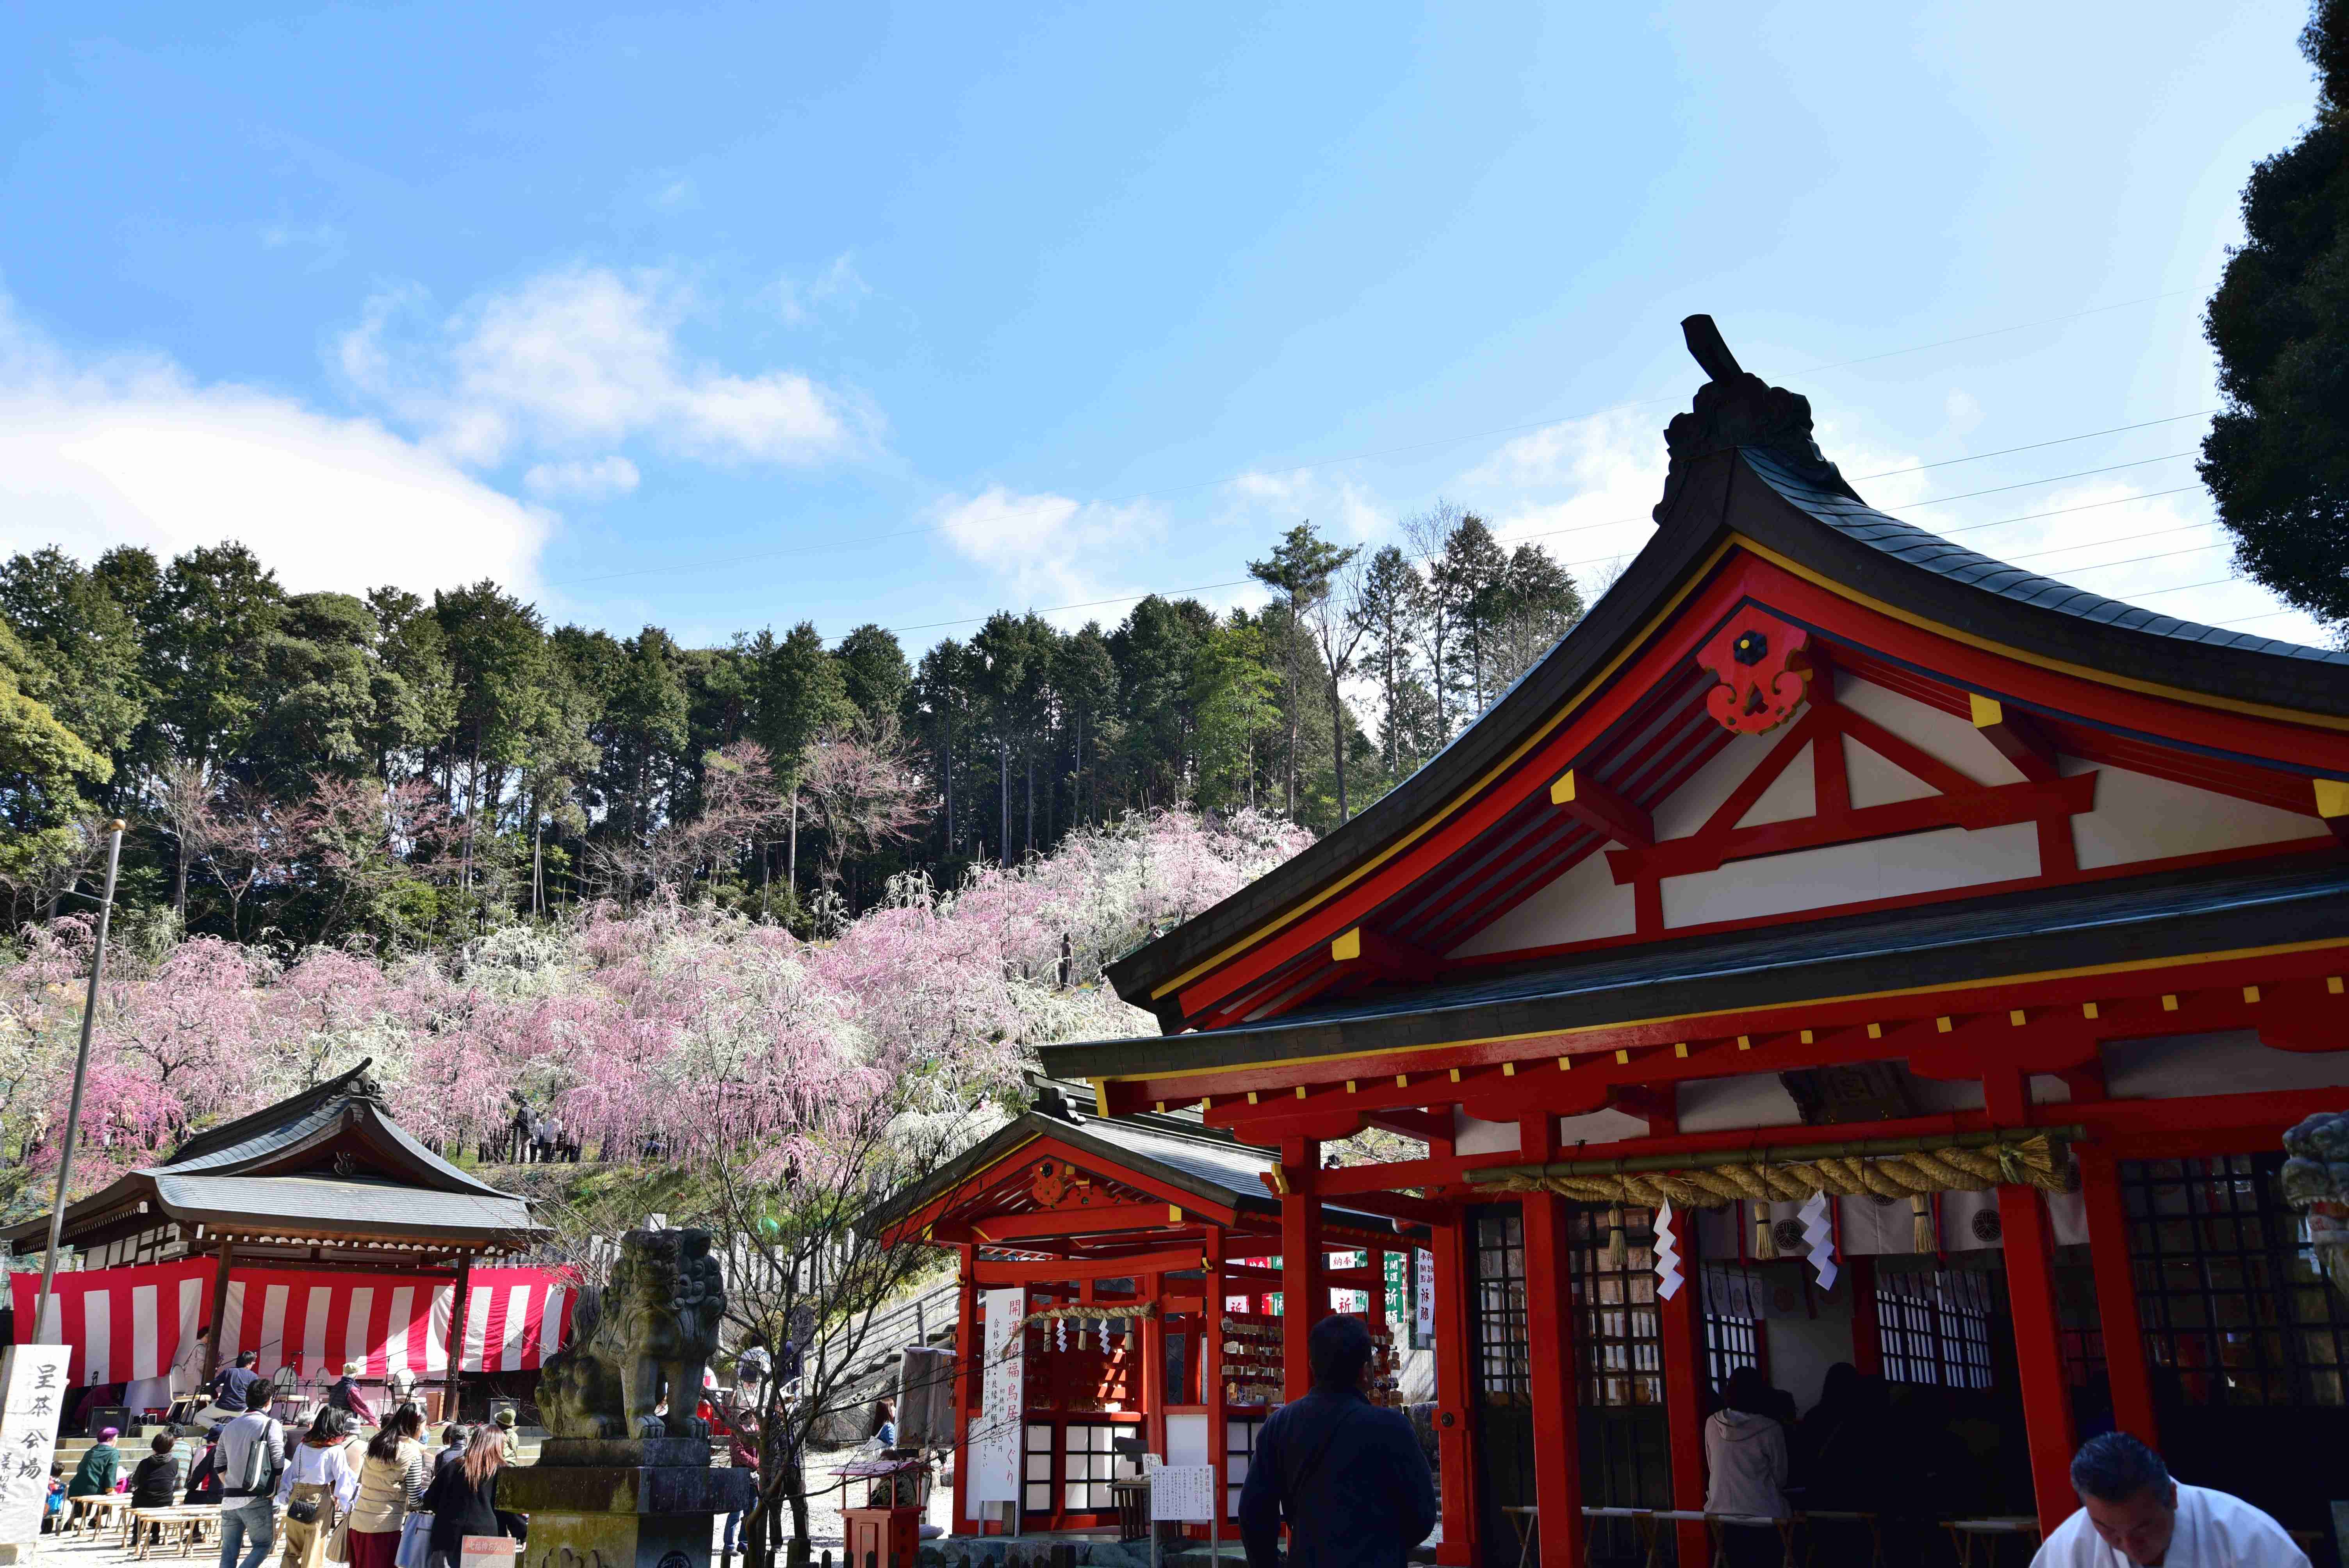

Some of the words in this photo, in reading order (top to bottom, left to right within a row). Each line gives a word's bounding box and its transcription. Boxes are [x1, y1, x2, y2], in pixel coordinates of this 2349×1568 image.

[1390, 1260, 1398, 1281] 開運
[16, 1364, 57, 1480] 呈茶会場
